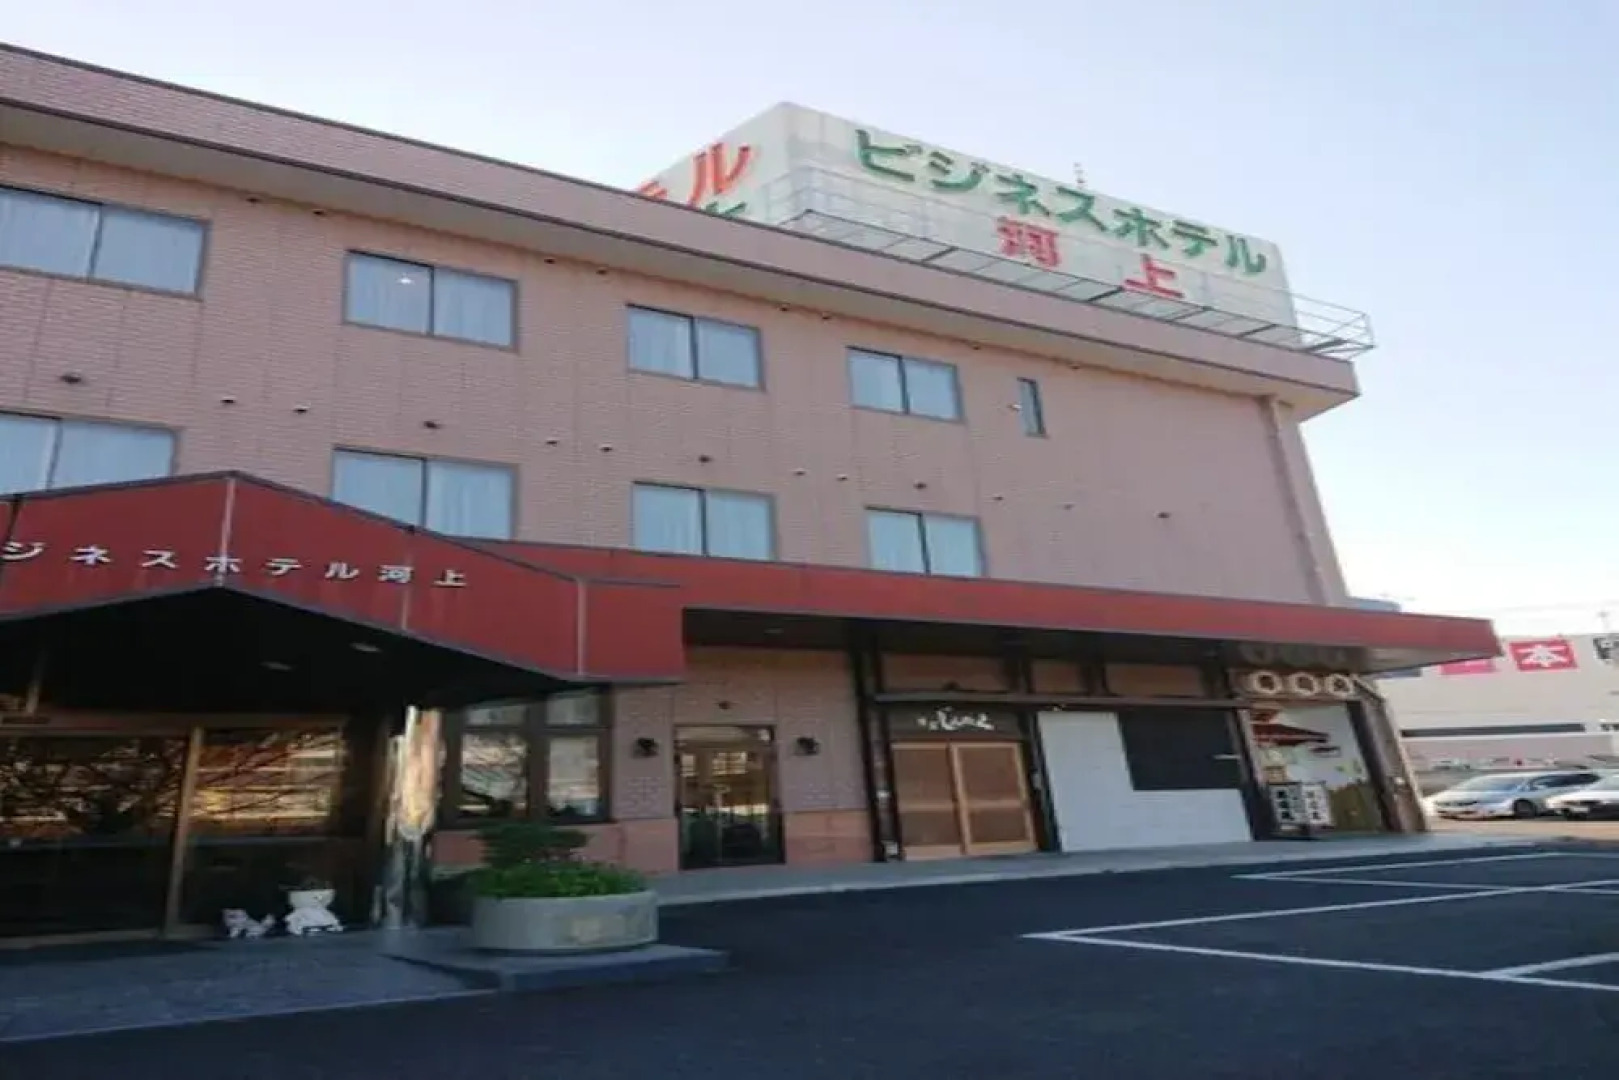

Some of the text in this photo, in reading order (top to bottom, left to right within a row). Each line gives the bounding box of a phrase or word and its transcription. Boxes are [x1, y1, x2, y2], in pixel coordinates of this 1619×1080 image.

[855, 129, 1267, 275] ビジネスホテル
[998, 216, 1184, 299] 河上
